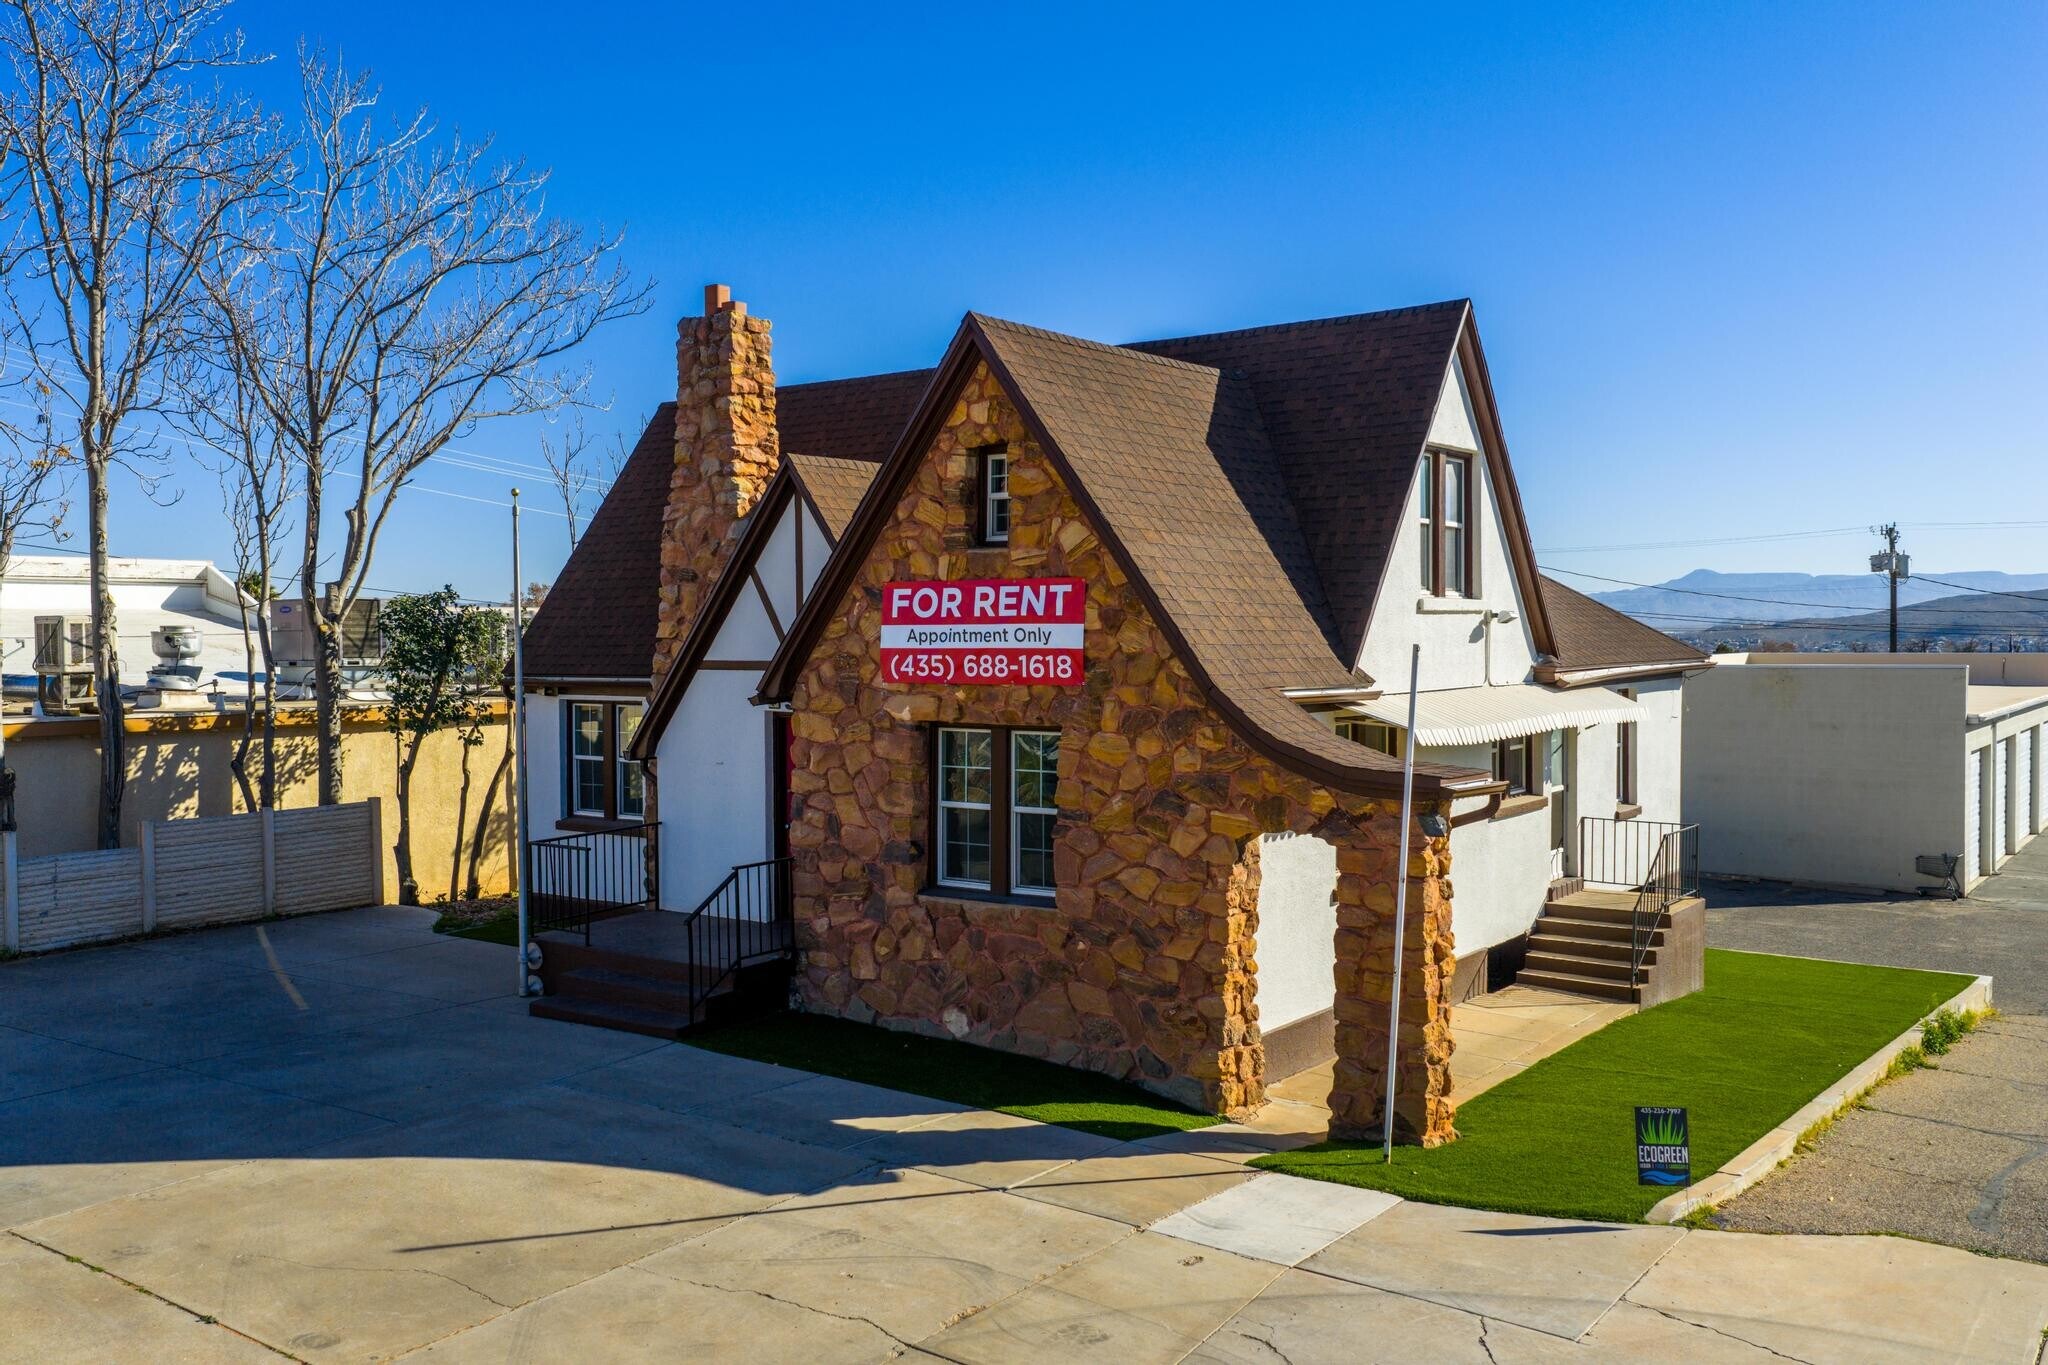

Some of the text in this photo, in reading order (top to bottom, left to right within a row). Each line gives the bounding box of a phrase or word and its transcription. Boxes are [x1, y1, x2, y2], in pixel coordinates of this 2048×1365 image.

[891, 584, 1073, 618] FOR RENT
[906, 627, 1052, 646] Appointment Only
[890, 654, 1072, 680] (435) 688-1618
[1638, 1145, 1689, 1163] ECOGREEN
